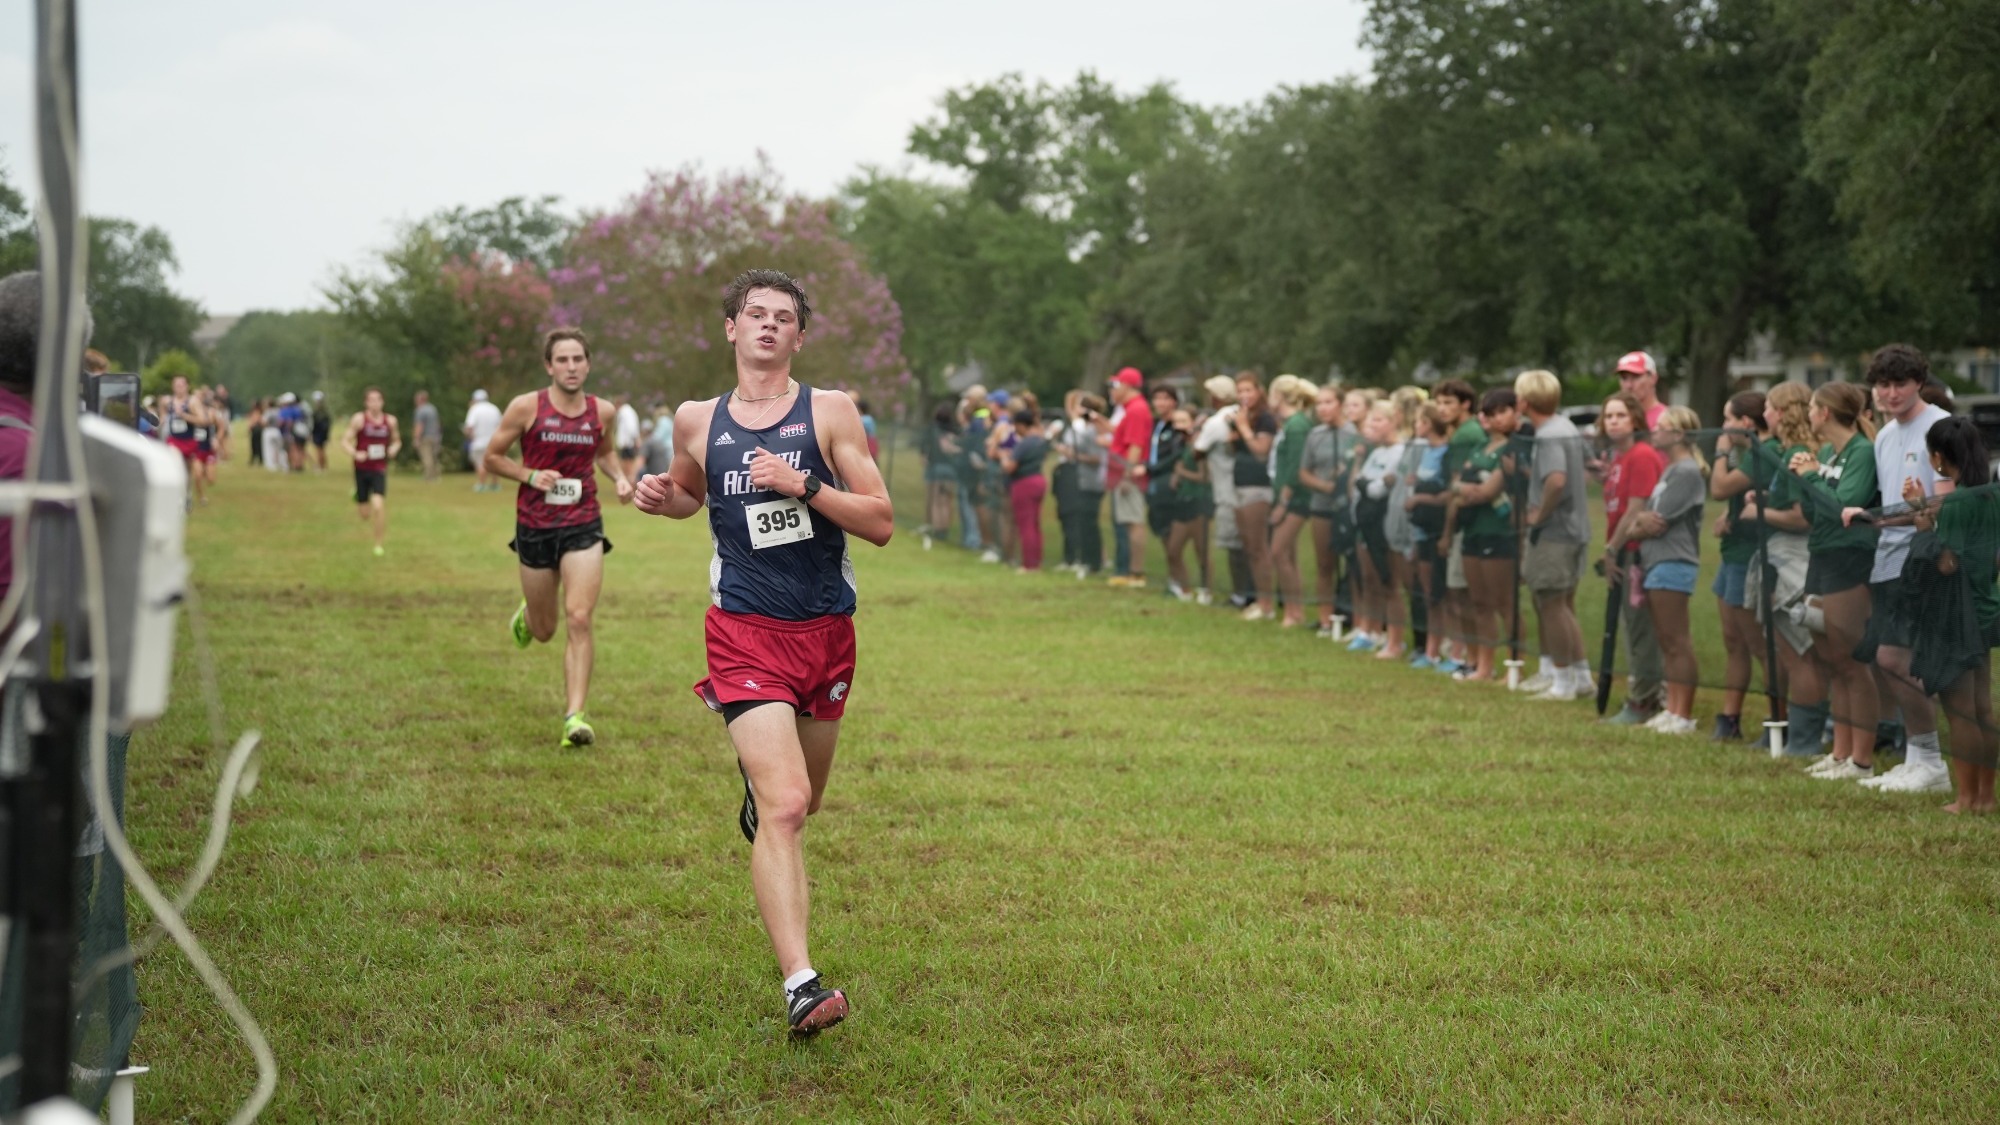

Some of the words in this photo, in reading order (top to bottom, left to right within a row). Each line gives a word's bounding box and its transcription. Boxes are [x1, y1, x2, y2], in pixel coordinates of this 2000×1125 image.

[780, 422, 806, 438] SBC
[541, 432, 594, 445] LOUISIANA
[714, 438, 735, 446] adidas
[741, 450, 802, 475] STH
[756, 507, 801, 534] 395
